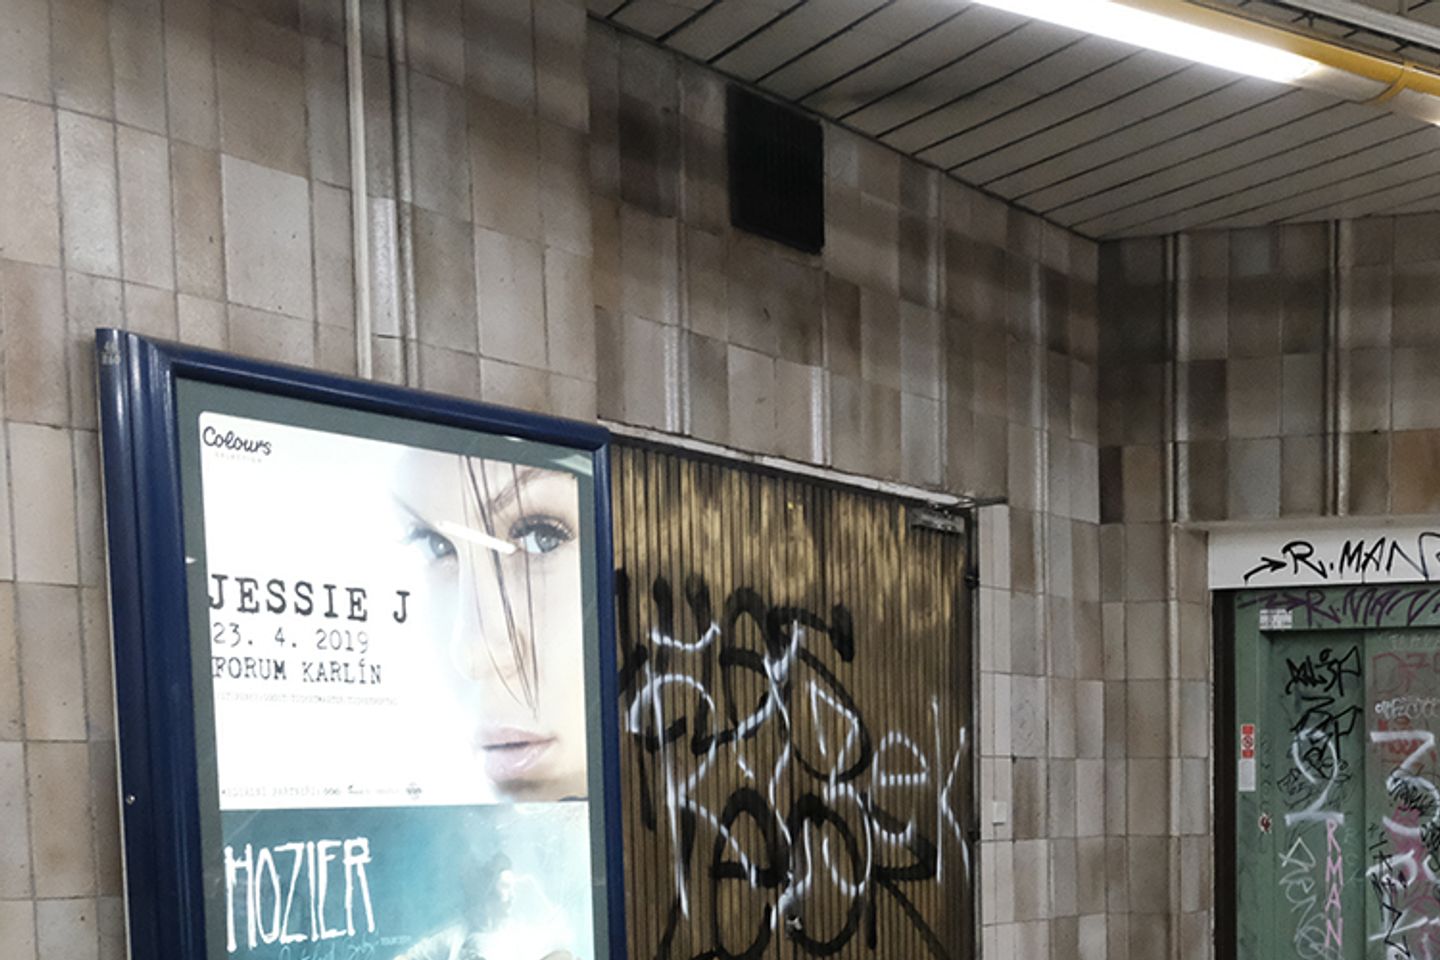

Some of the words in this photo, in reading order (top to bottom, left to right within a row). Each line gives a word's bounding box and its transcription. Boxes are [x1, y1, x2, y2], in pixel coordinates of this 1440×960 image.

[202, 426, 273, 456] Colours
[206, 573, 368, 622] JESSIE
[393, 590, 411, 624] J
[213, 621, 254, 648] 23.
[274, 626, 297, 649] 4.
[315, 628, 369, 654] 2019
[212, 655, 287, 681] FORUM
[302, 658, 382, 685] KARLÍN
[224, 836, 376, 954] HOZIER
